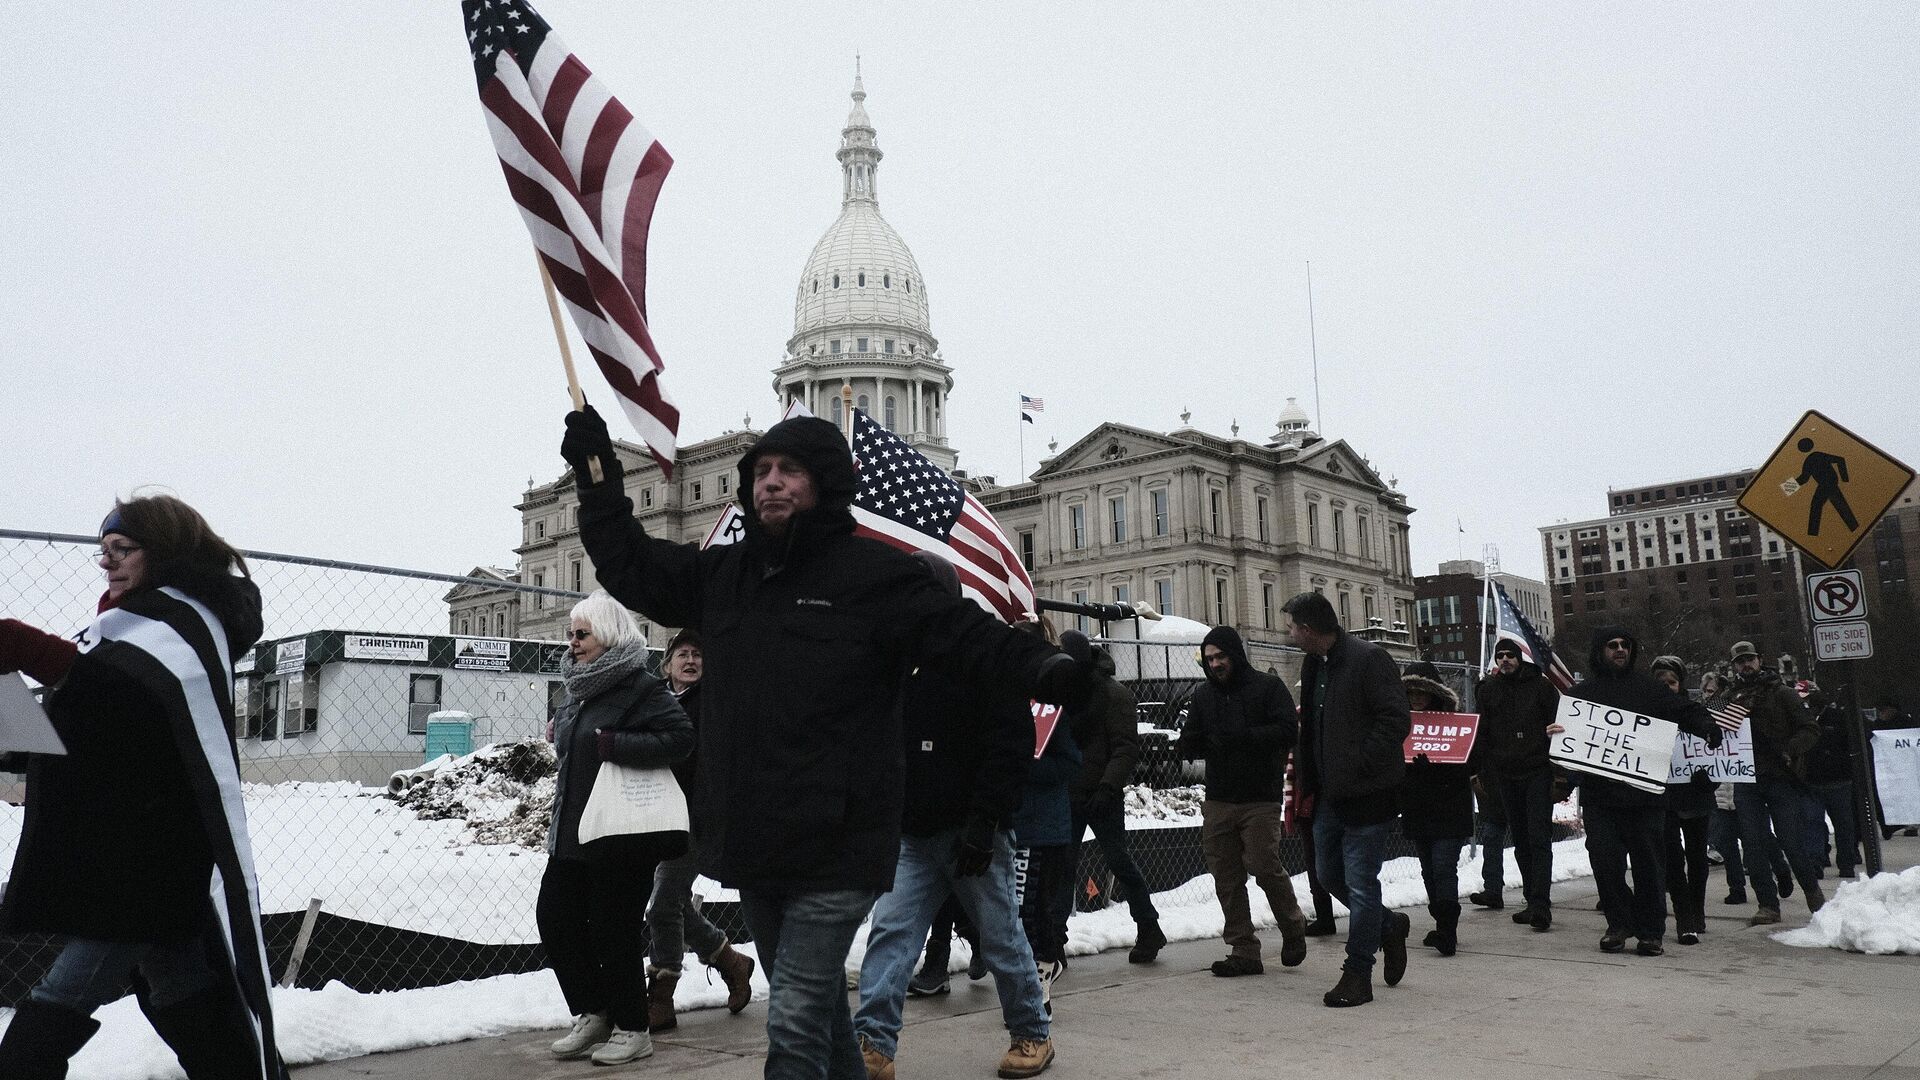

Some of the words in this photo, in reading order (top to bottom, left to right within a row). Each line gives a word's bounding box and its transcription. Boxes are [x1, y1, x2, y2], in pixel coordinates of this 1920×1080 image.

[1820, 631, 1840, 640] THIS
[1844, 629, 1866, 639] SIDE
[359, 638, 424, 649] CHRISTMAN
[473, 641, 508, 651] SUMMIT
[1825, 643, 1836, 653] OF
[1841, 641, 1863, 652] SIGN
[1568, 700, 1651, 732] STOP
[1586, 723, 1636, 750] THE
[1412, 742, 1451, 751] 2020
[1895, 739, 1911, 749] AN
[1561, 737, 1648, 775] STEAL
[1721, 759, 1757, 777] Votes
